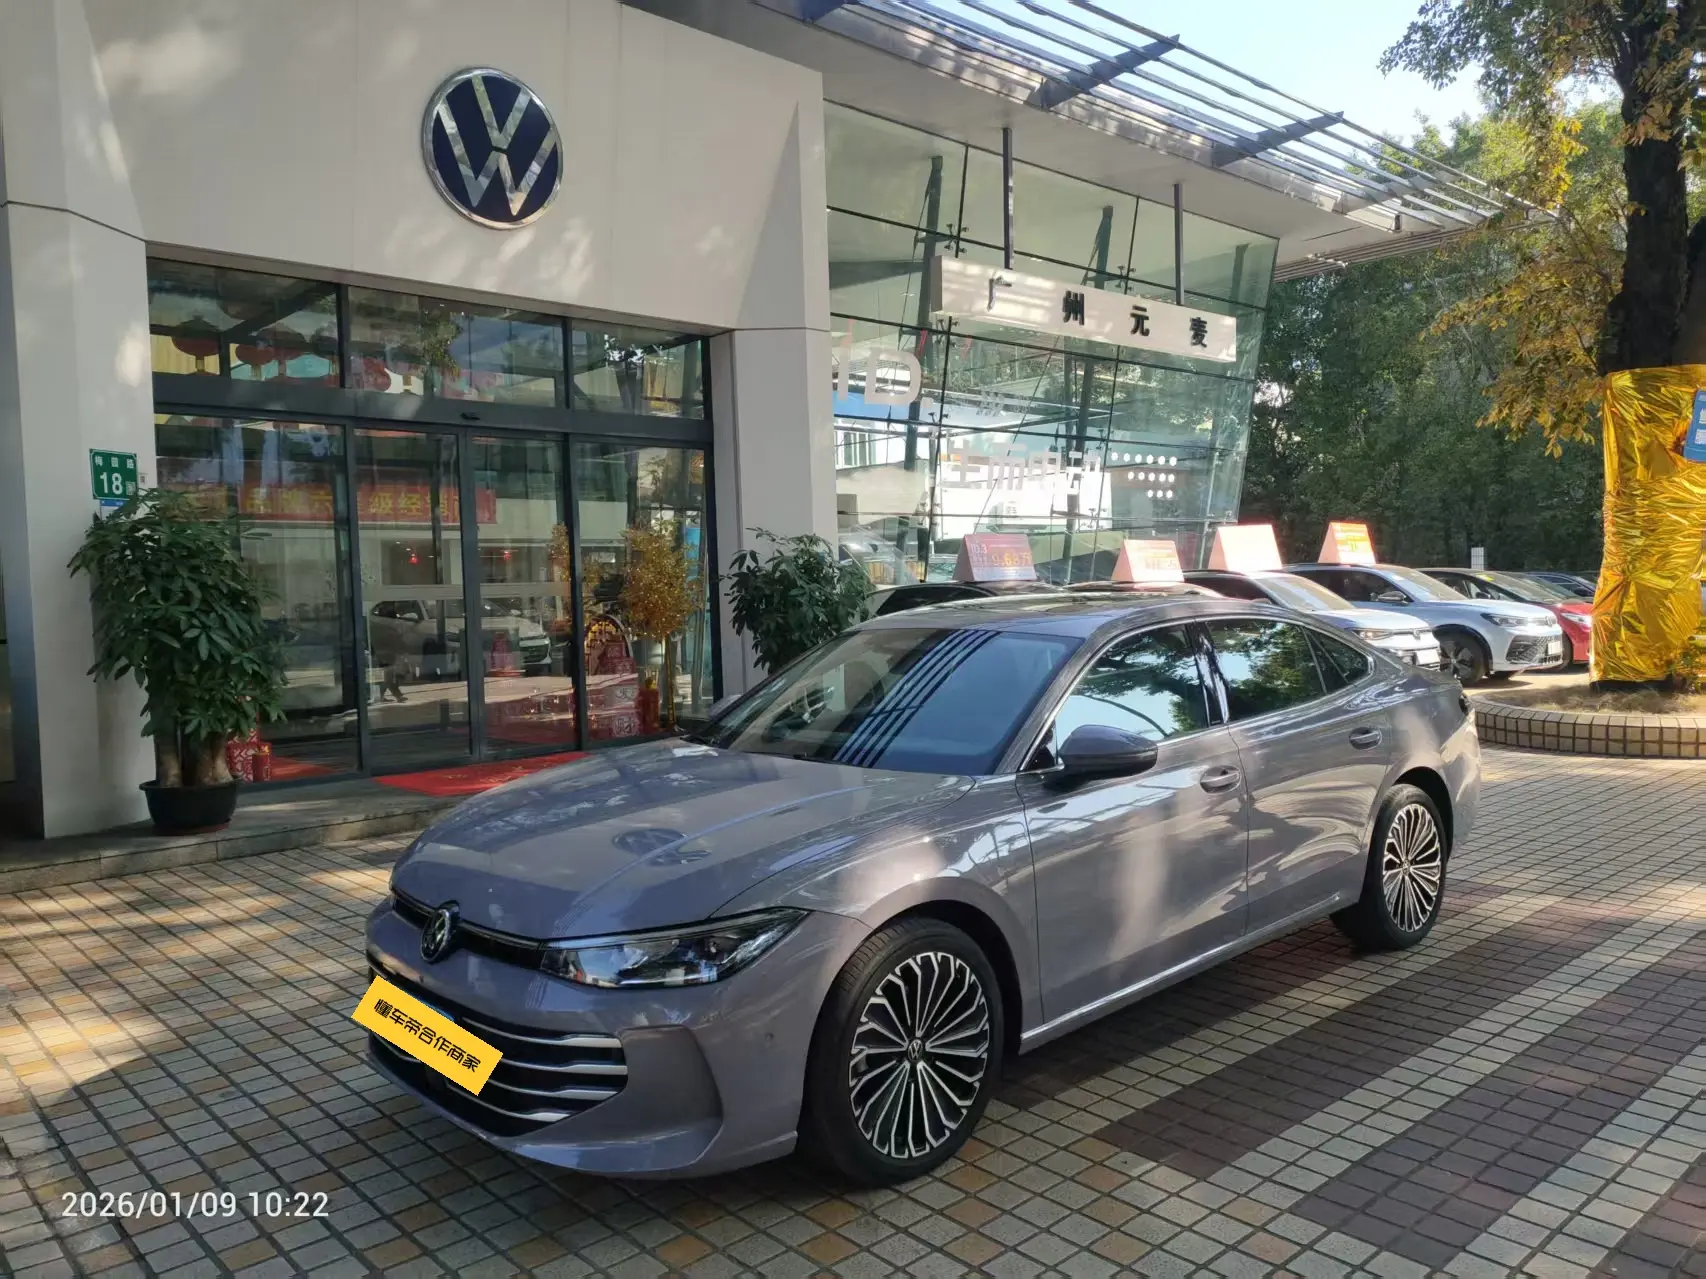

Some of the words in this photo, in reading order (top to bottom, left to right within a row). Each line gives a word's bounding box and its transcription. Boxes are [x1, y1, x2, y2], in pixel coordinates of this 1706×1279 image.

[986, 274, 1209, 348] 广州元麦
[99, 471, 123, 495] 18
